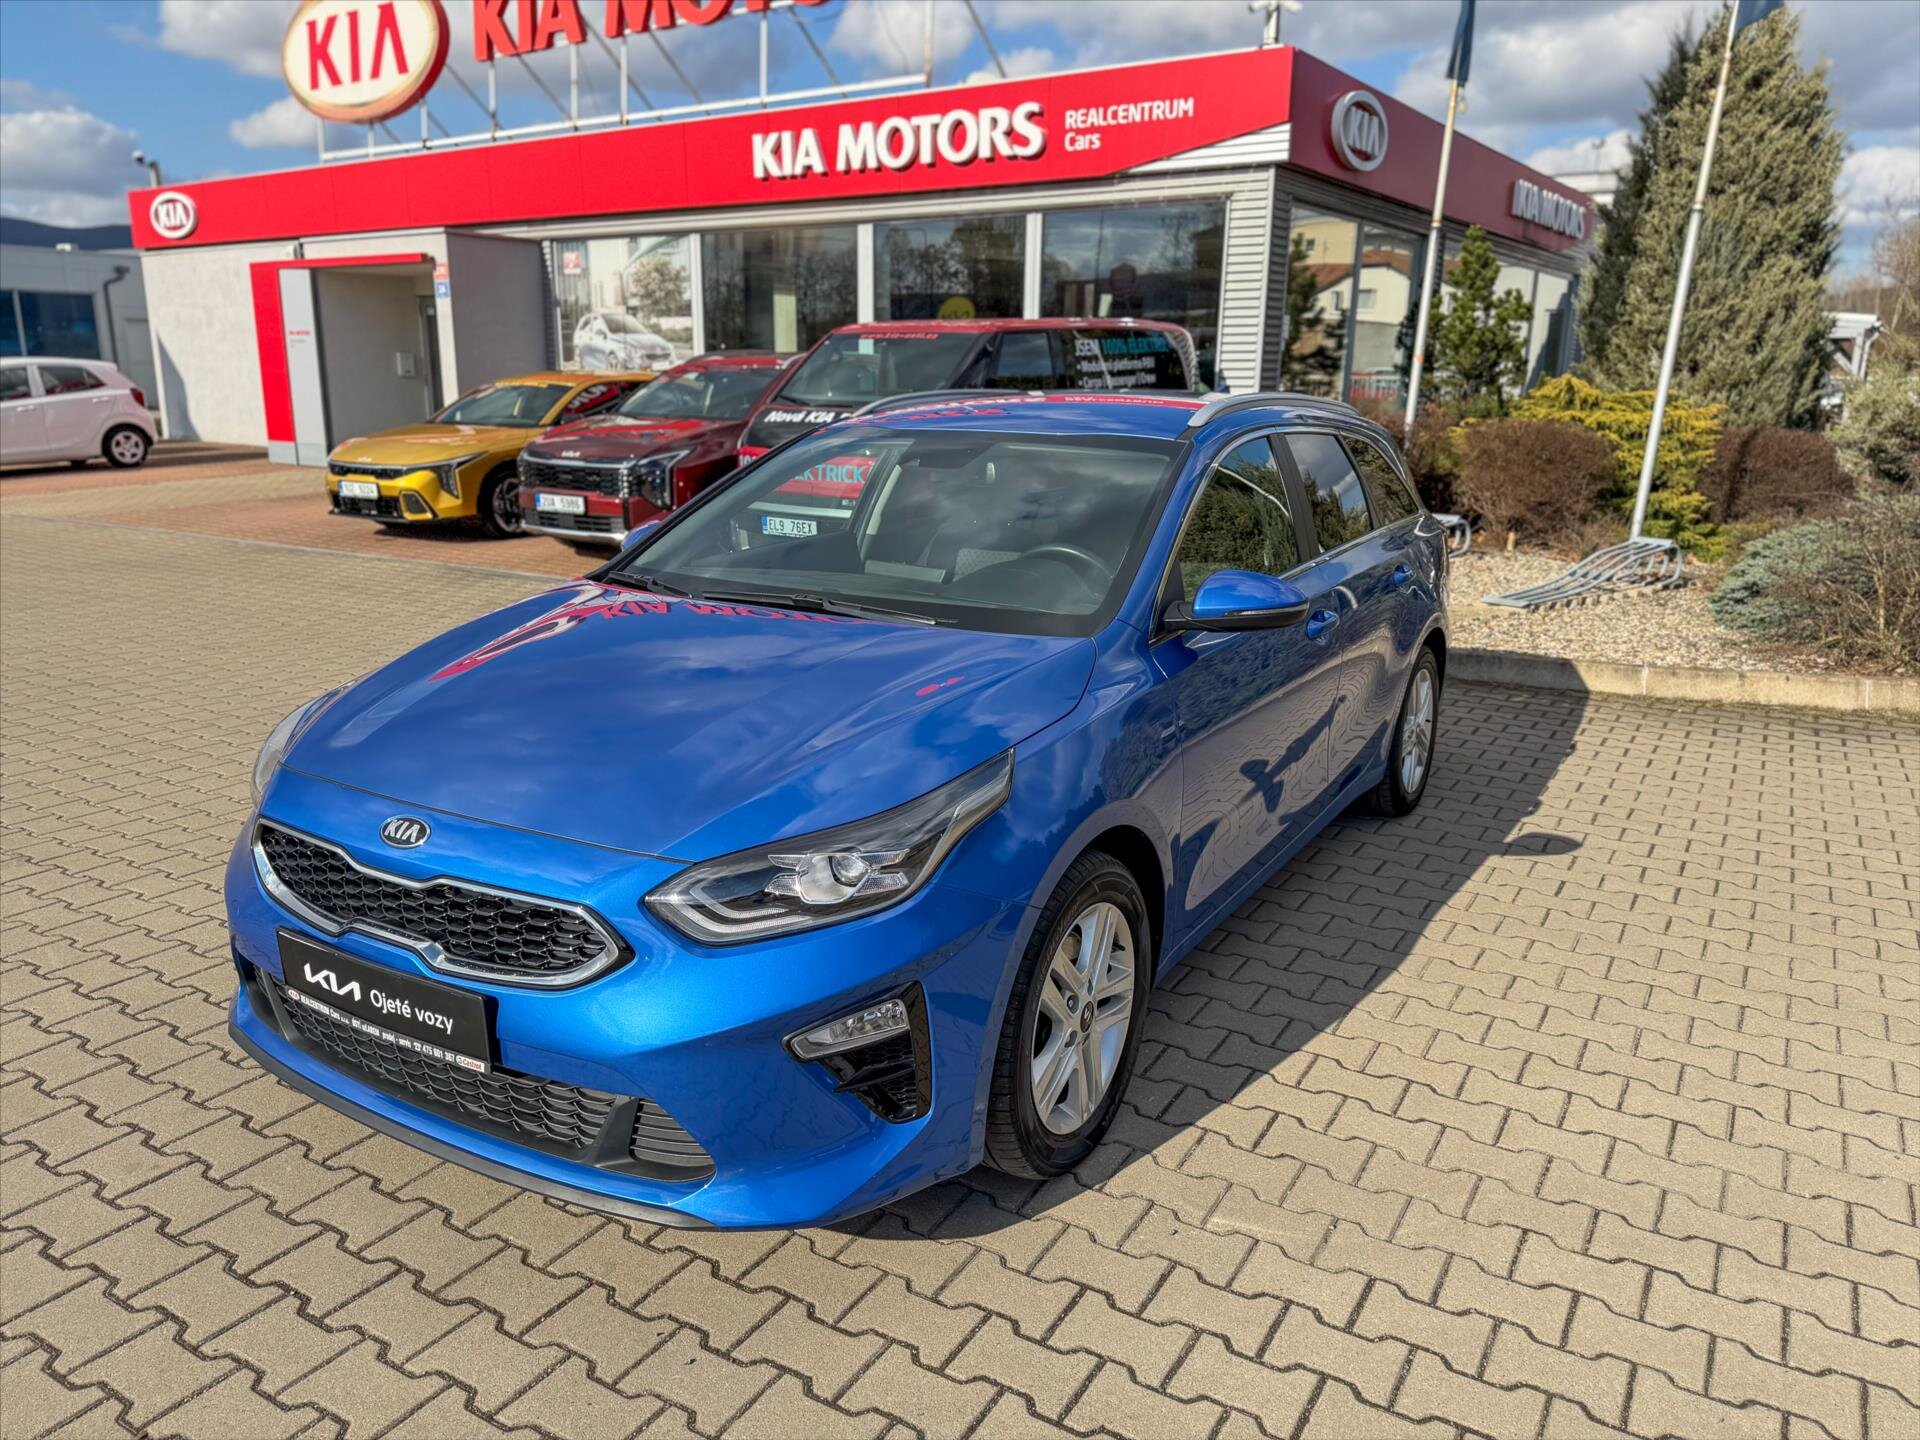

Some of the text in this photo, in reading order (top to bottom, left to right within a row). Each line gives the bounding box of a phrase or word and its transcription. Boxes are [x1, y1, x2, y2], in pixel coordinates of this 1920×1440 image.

[305, 2, 409, 91] KIA
[472, 0, 587, 61] KIA
[1064, 97, 1195, 131] REALCENTRUM
[1348, 104, 1380, 160] KIA
[752, 101, 1046, 179] KIA MOTORS
[1064, 130, 1101, 152] Cars
[157, 201, 188, 228] KIA
[1540, 188, 1586, 240] MOTORS
[804, 411, 836, 423] KIA
[768, 518, 813, 534] EL9 76EX
[384, 819, 420, 843] KIA
[370, 989, 411, 1018] Ojeté
[415, 1007, 453, 1035] vozy
